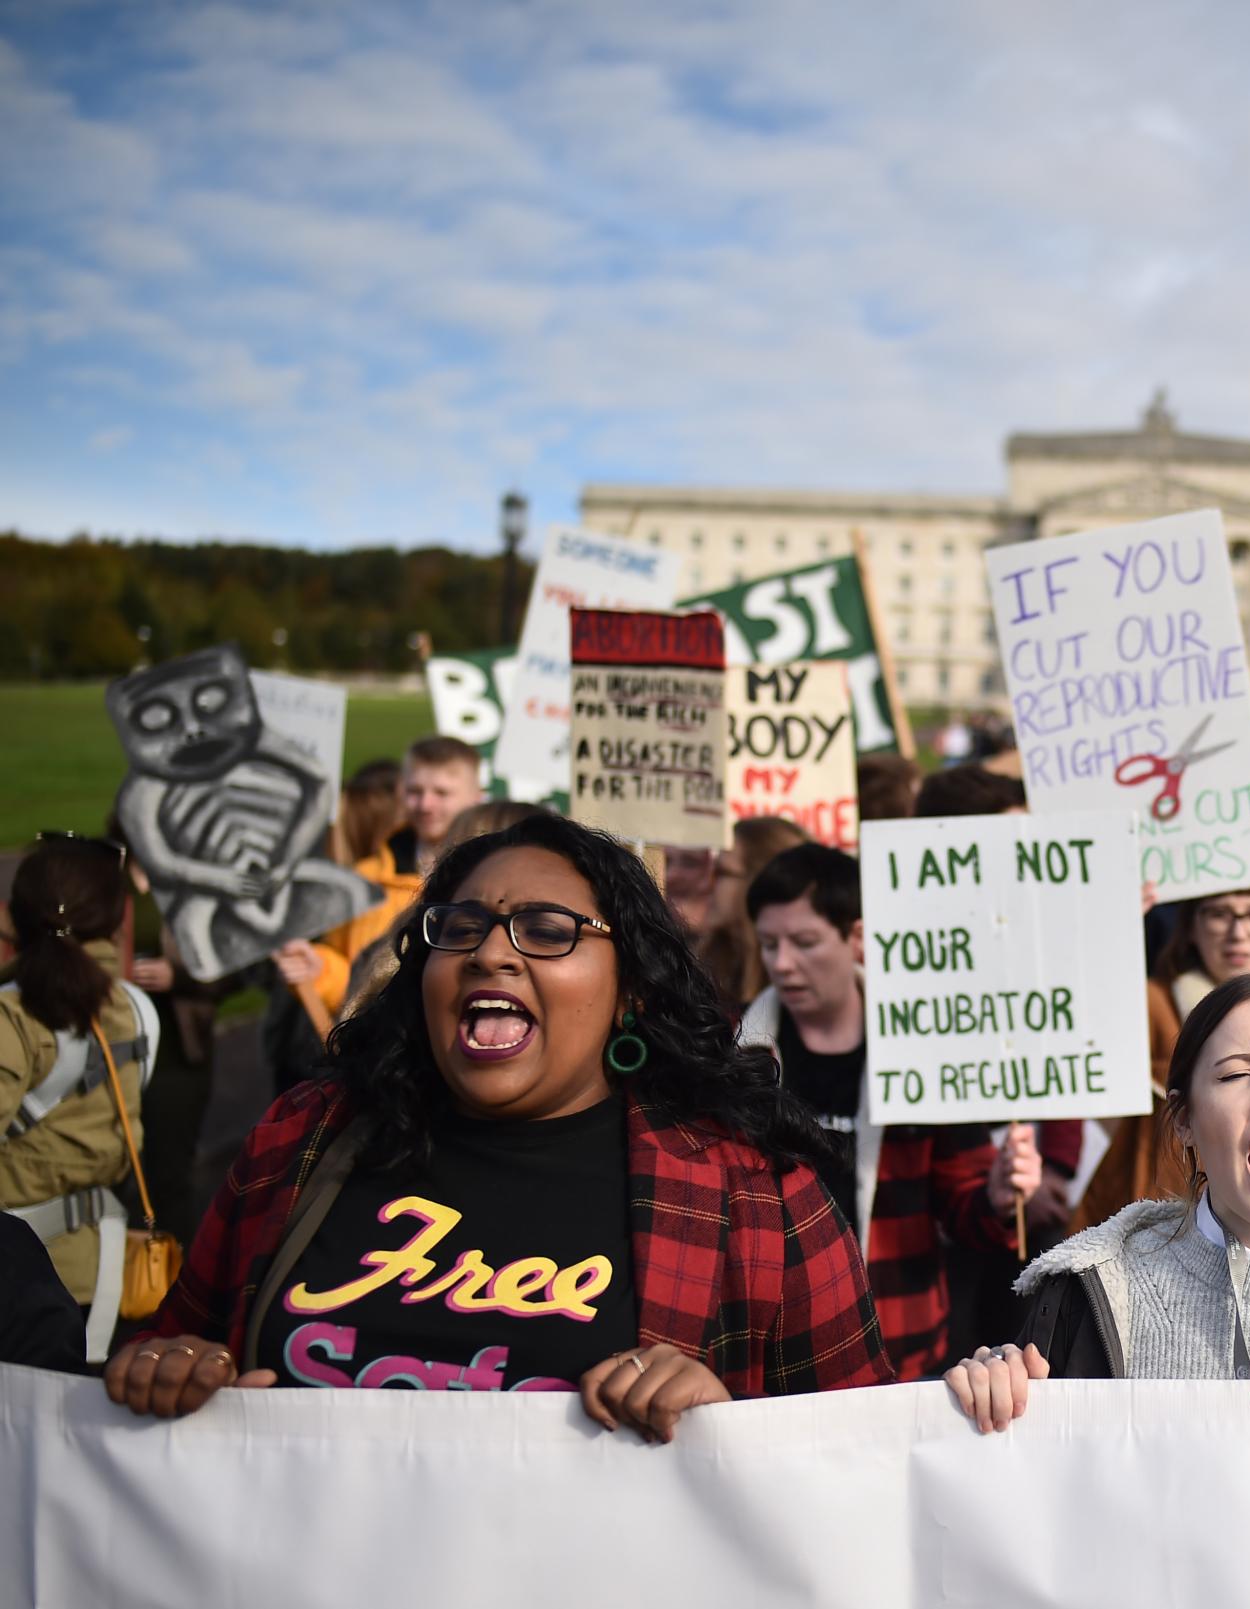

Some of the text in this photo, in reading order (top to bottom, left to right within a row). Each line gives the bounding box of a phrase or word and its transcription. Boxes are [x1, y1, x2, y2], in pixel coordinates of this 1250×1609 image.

[1001, 536, 1206, 626] IF YOU
[1011, 610, 1210, 682] CUT OUR
[573, 675, 599, 695] AN
[746, 667, 809, 706] MY
[1013, 645, 1247, 740] REPRODUCTIVE
[575, 702, 607, 719] FOR
[615, 703, 649, 721] THE
[656, 701, 706, 726] RICH
[576, 737, 714, 771] A DISASTER
[1027, 719, 1170, 788] RIGHTS
[576, 772, 625, 800] FOR
[631, 775, 672, 802] THE
[742, 767, 800, 794] MY
[889, 839, 1094, 890] I AM NOT
[874, 927, 974, 973] YOUR
[878, 987, 1074, 1036] INCUBATOR
[876, 1069, 924, 1103] TO
[283, 1195, 613, 1323] Free
